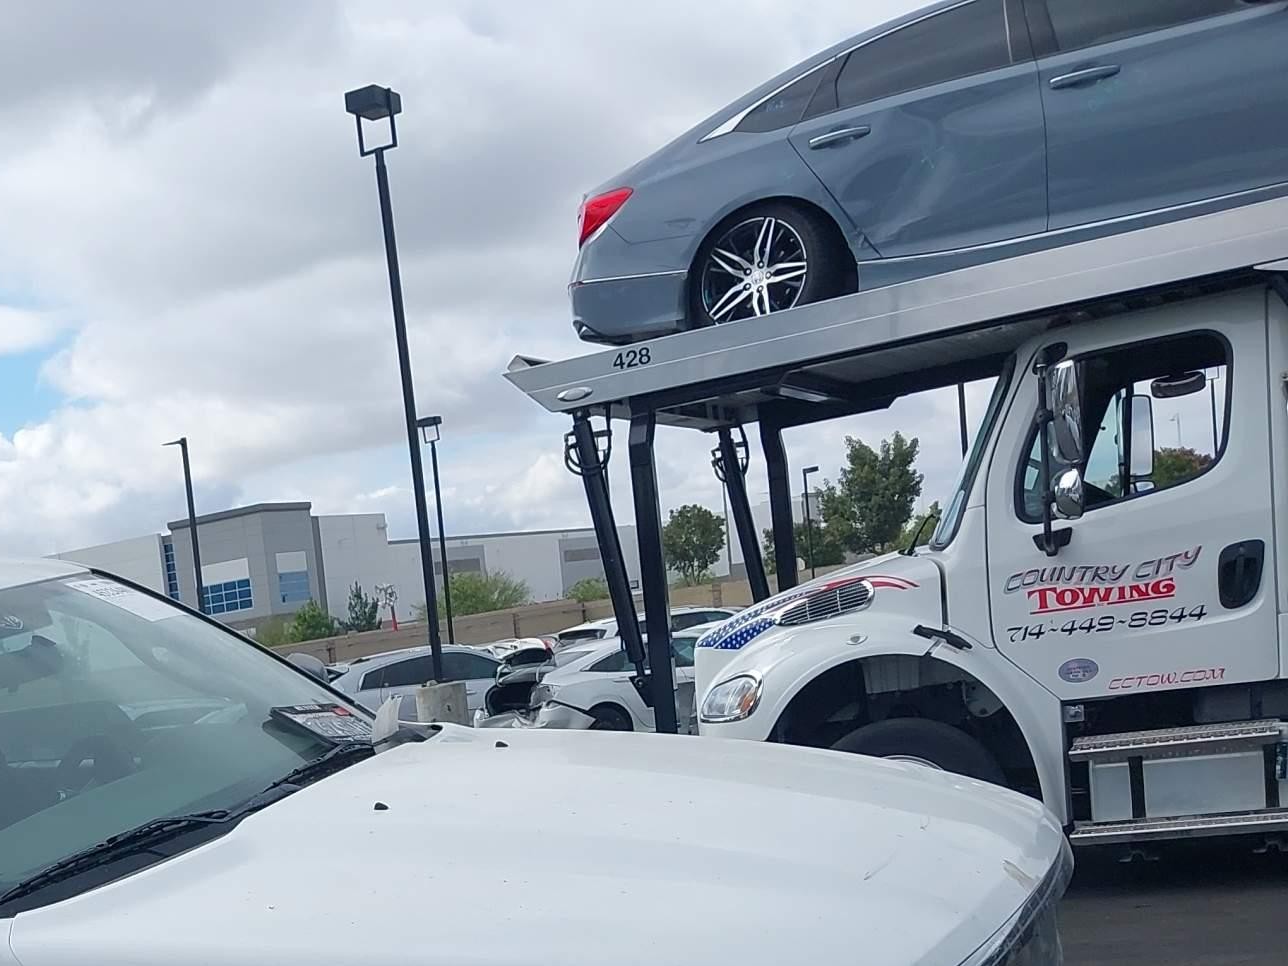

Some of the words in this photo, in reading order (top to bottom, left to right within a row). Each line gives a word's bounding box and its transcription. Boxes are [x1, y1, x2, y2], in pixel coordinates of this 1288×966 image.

[613, 347, 651, 369] 428
[1004, 564, 1130, 594] COUNTRY
[1134, 545, 1202, 582] CITY
[1027, 577, 1176, 610] TOWING
[1108, 668, 1226, 690] CCTOW.COM
